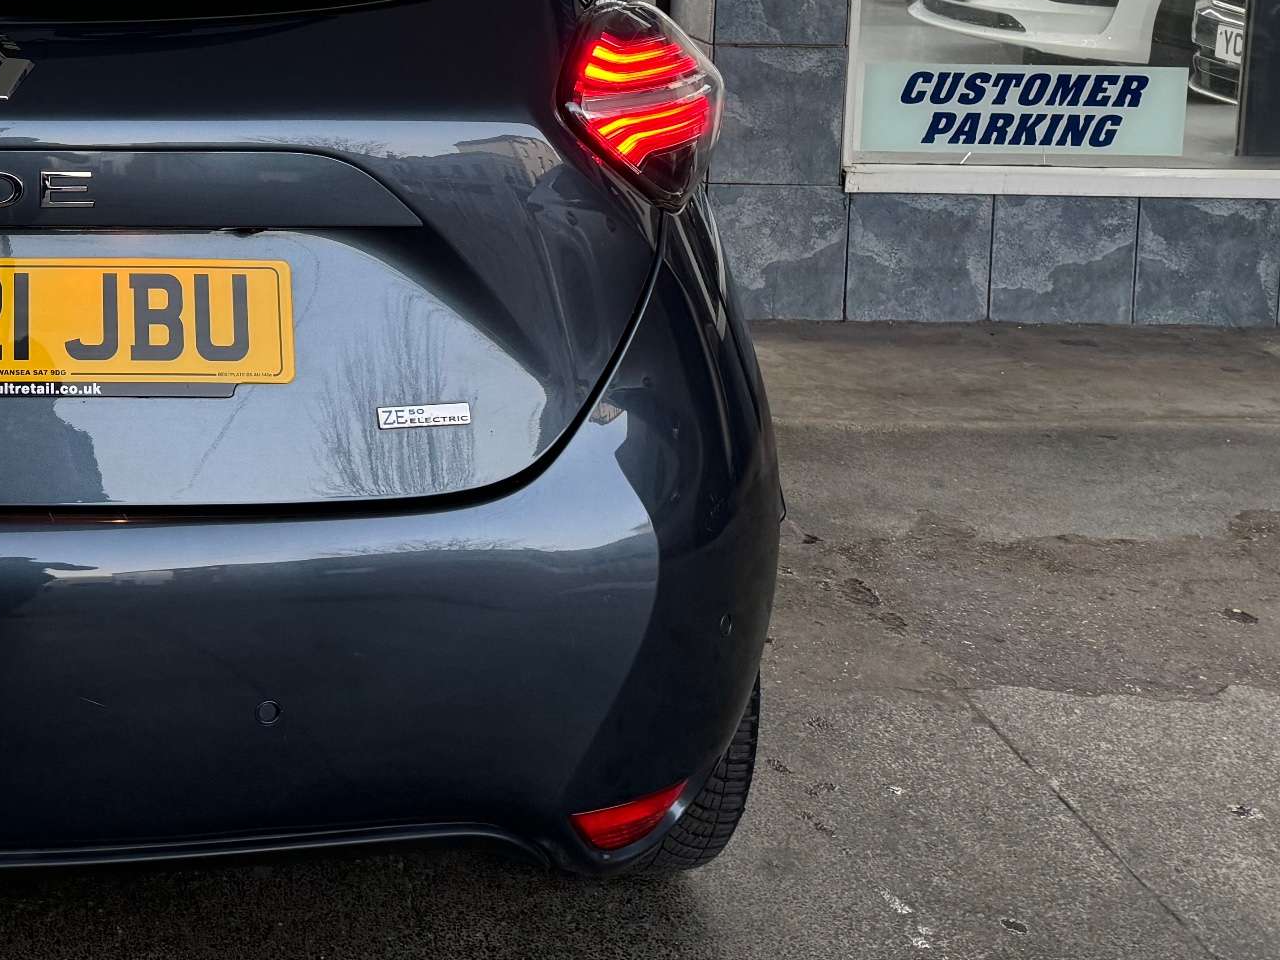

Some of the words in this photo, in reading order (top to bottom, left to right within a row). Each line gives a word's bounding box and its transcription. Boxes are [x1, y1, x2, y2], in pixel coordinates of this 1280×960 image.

[900, 71, 1149, 108] CUSTOMER
[920, 111, 1123, 148] PARKING
[64, 272, 250, 362] JBU
[409, 415, 469, 424] ELECTRIC
